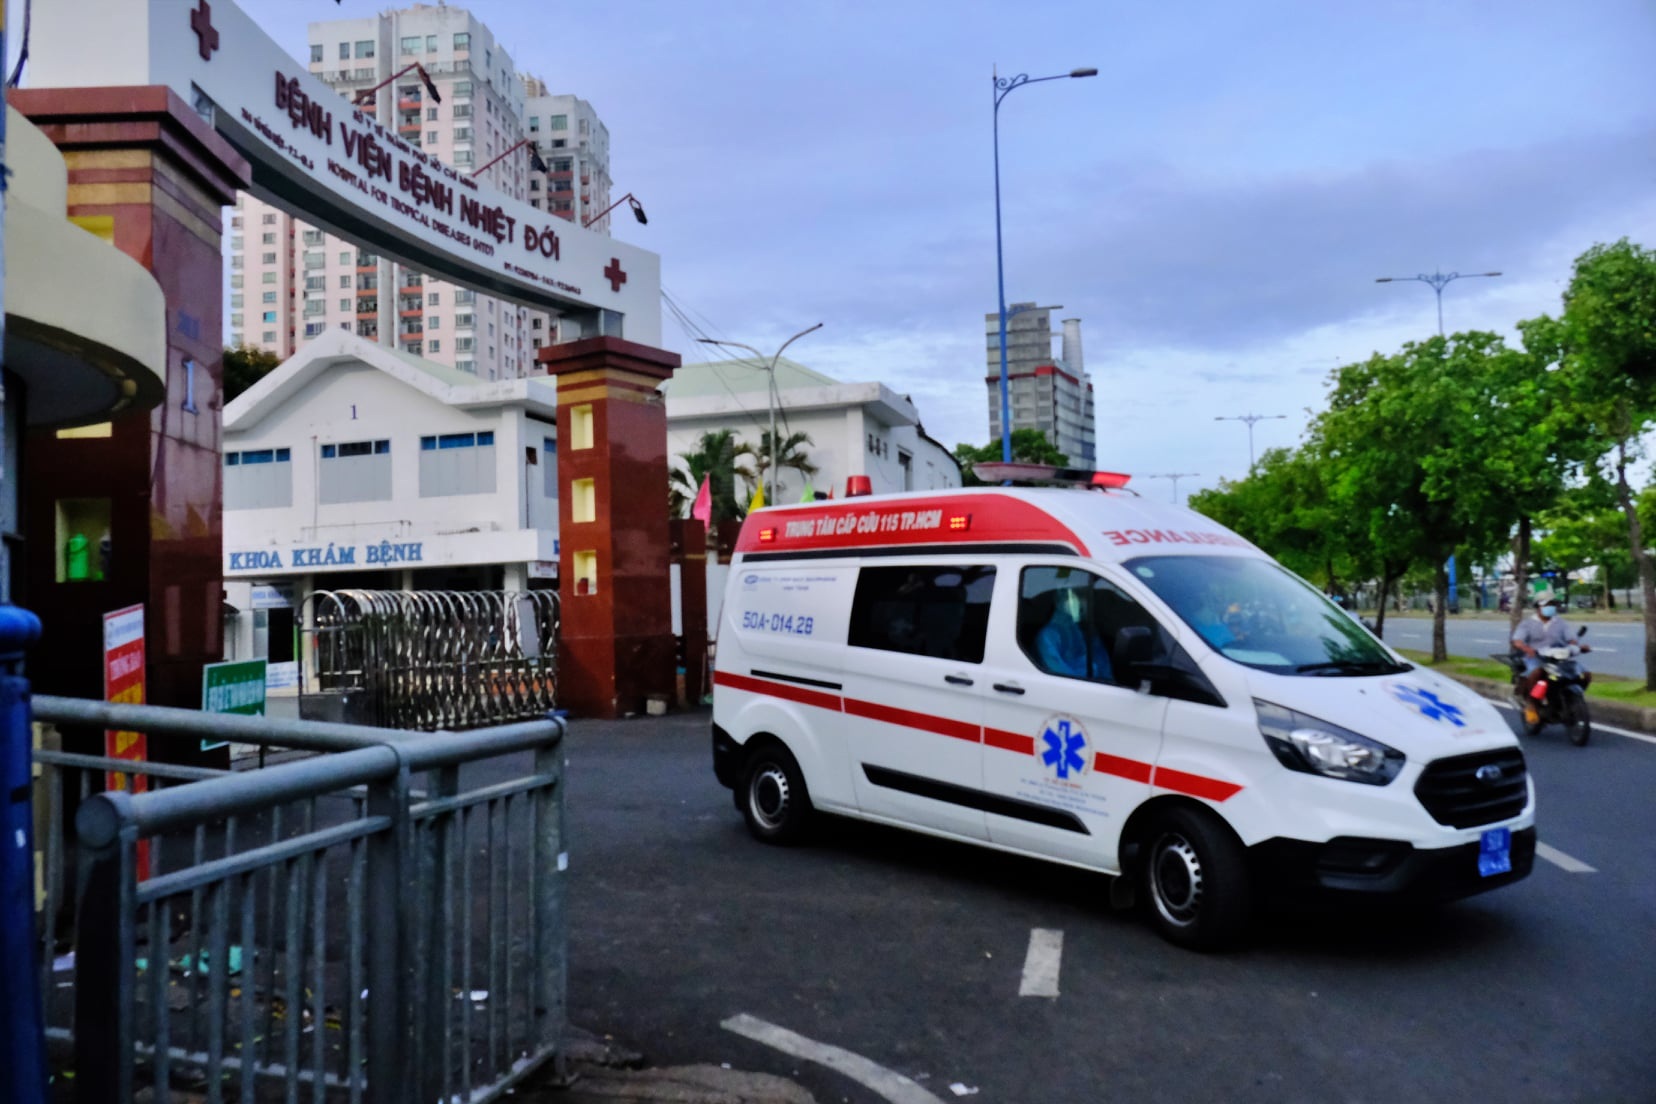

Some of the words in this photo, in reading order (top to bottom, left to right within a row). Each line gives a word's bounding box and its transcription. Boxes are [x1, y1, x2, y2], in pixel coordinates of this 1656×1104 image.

[275, 70, 333, 146] BỆNH
[340, 121, 393, 184] VIỆN
[399, 159, 453, 217] BỆNH
[460, 193, 517, 245] NHIỆT
[524, 224, 560, 262] ĐỚI
[370, 185, 388, 205] FOR
[390, 195, 430, 229] TROPICAL
[785, 519, 816, 538] TRUNG
[816, 515, 837, 536] TÂM
[836, 511, 857, 535] CẤP
[881, 512, 899, 532] 115
[900, 509, 943, 531] TP.HCM
[229, 551, 283, 571] KHOA
[292, 542, 356, 568] KHÁM
[365, 539, 424, 567] BỆNH
